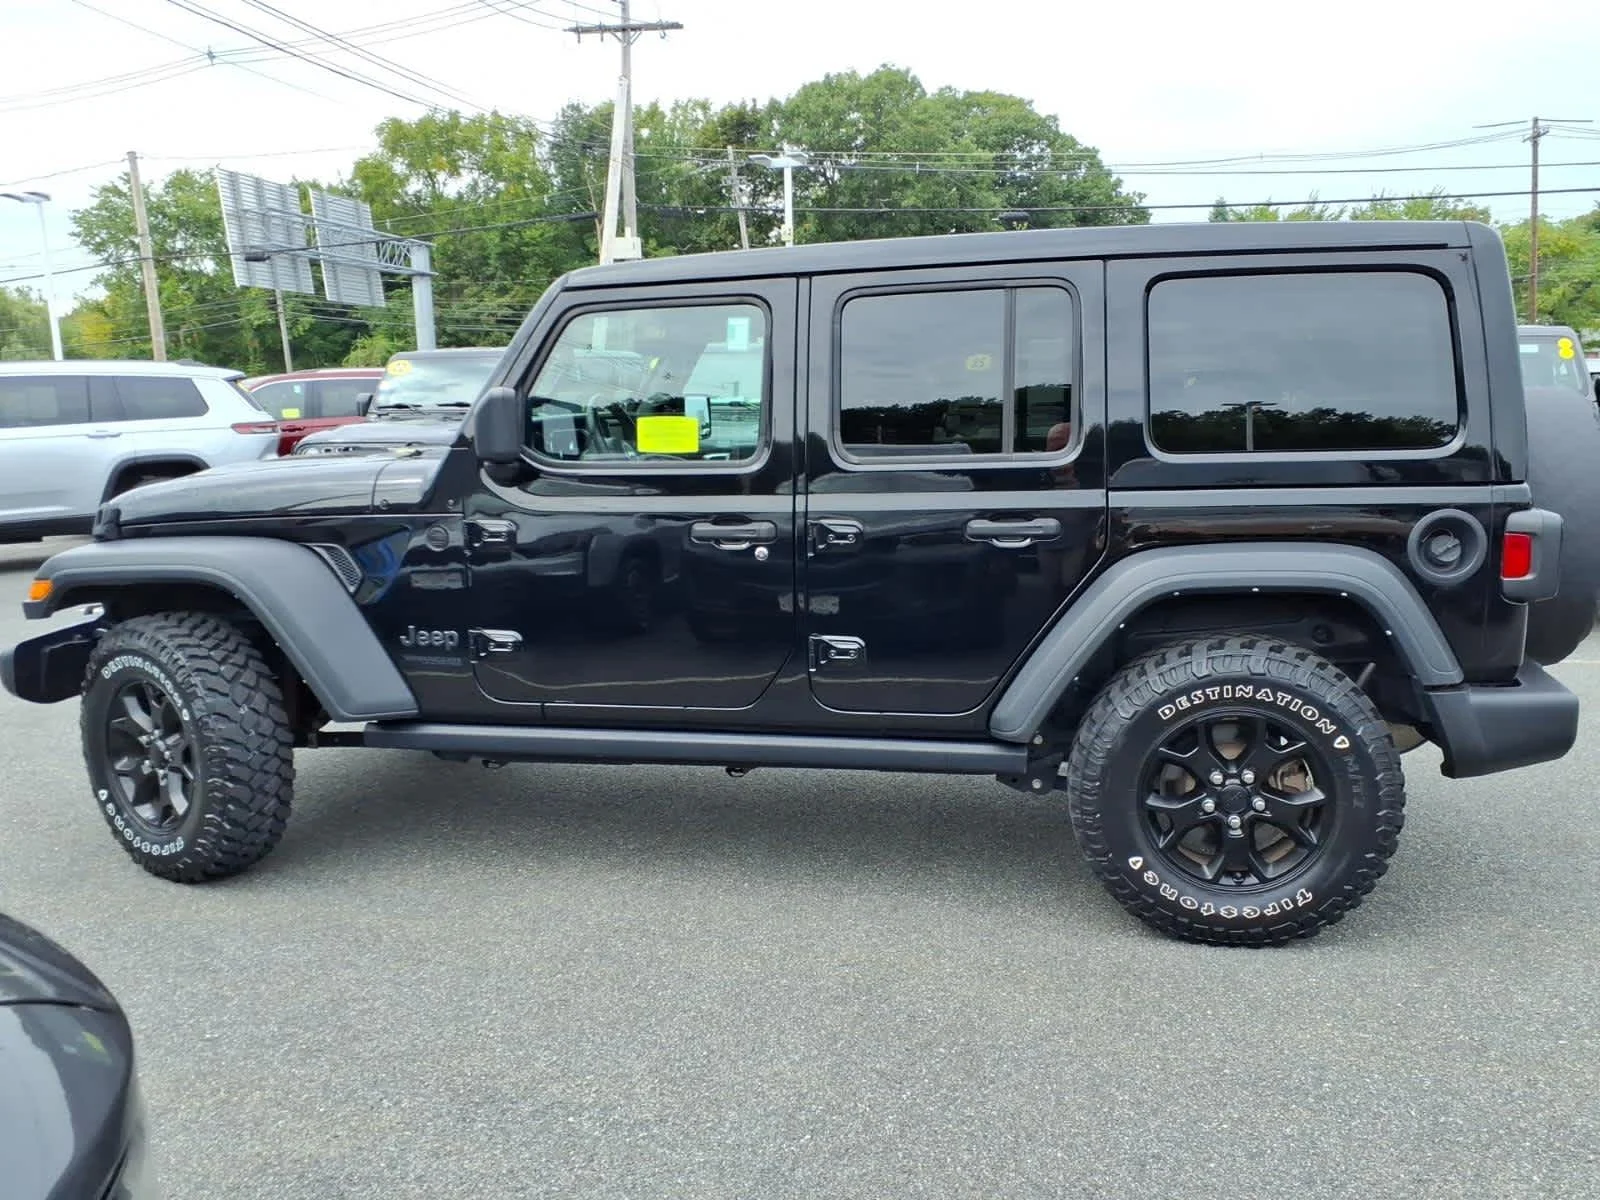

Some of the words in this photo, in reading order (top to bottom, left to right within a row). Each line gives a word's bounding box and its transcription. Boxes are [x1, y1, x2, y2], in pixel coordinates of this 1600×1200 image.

[400, 625, 459, 650] Jeep
[1158, 685, 1337, 734] DESTINATION
[1144, 870, 1313, 918] Firestone
